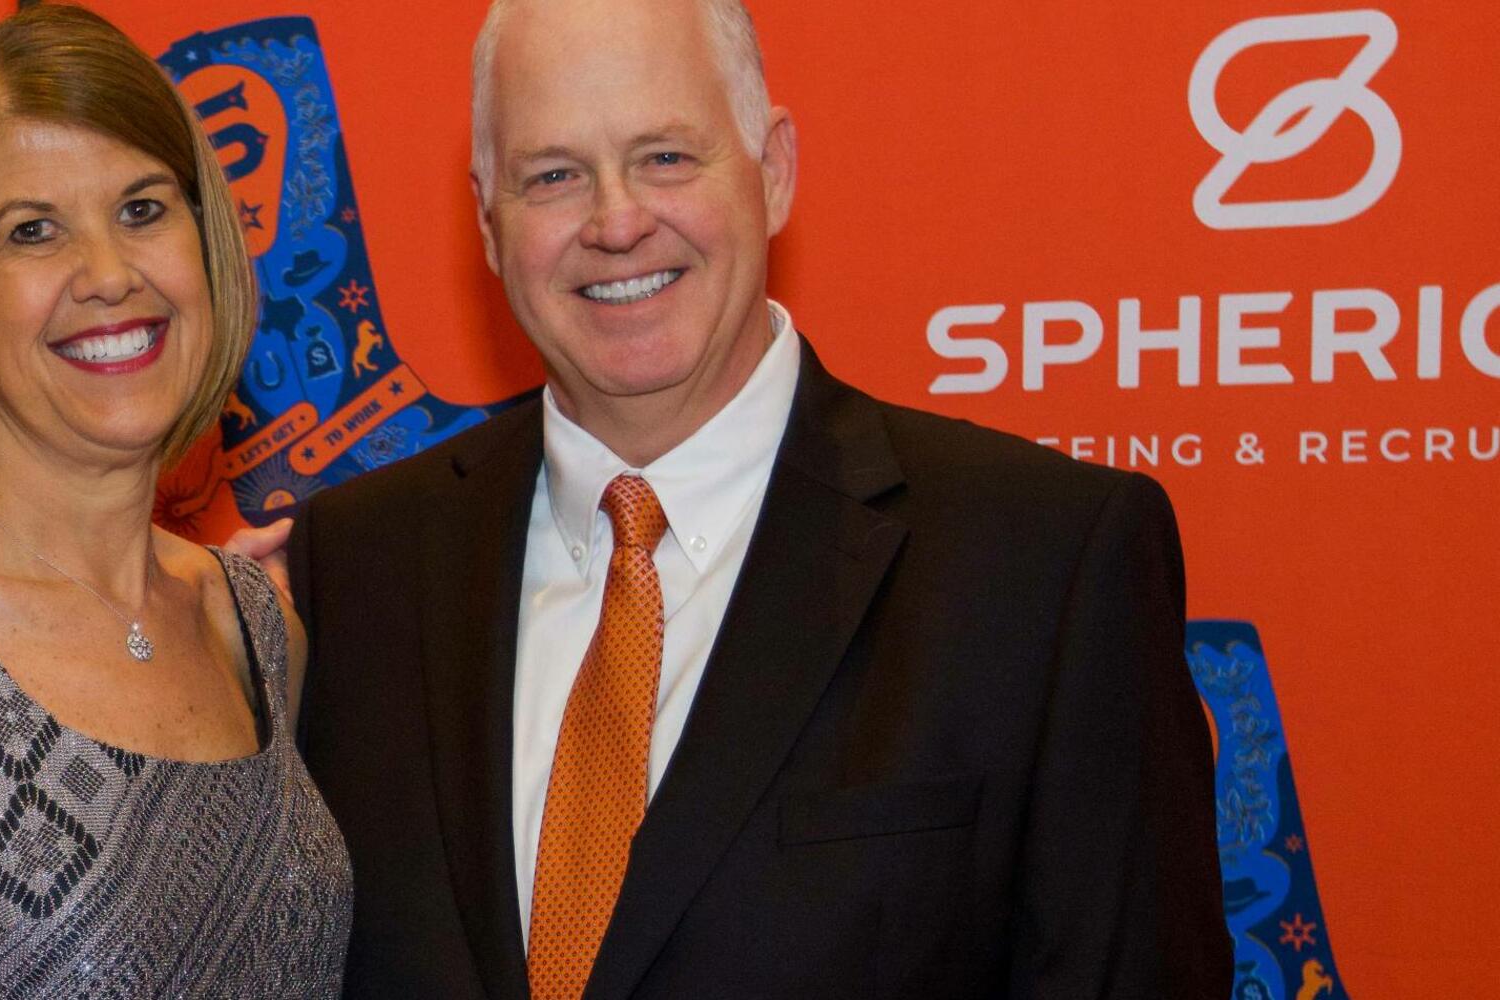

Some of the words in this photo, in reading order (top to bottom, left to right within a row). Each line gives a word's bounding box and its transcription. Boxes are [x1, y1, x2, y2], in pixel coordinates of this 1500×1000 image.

[271, 421, 296, 443] GET
[324, 429, 344, 446] TO
[343, 400, 382, 432] WORK
[1035, 433, 1202, 468] FING
[1234, 432, 1265, 466] &
[1298, 426, 1500, 465] RECRU
